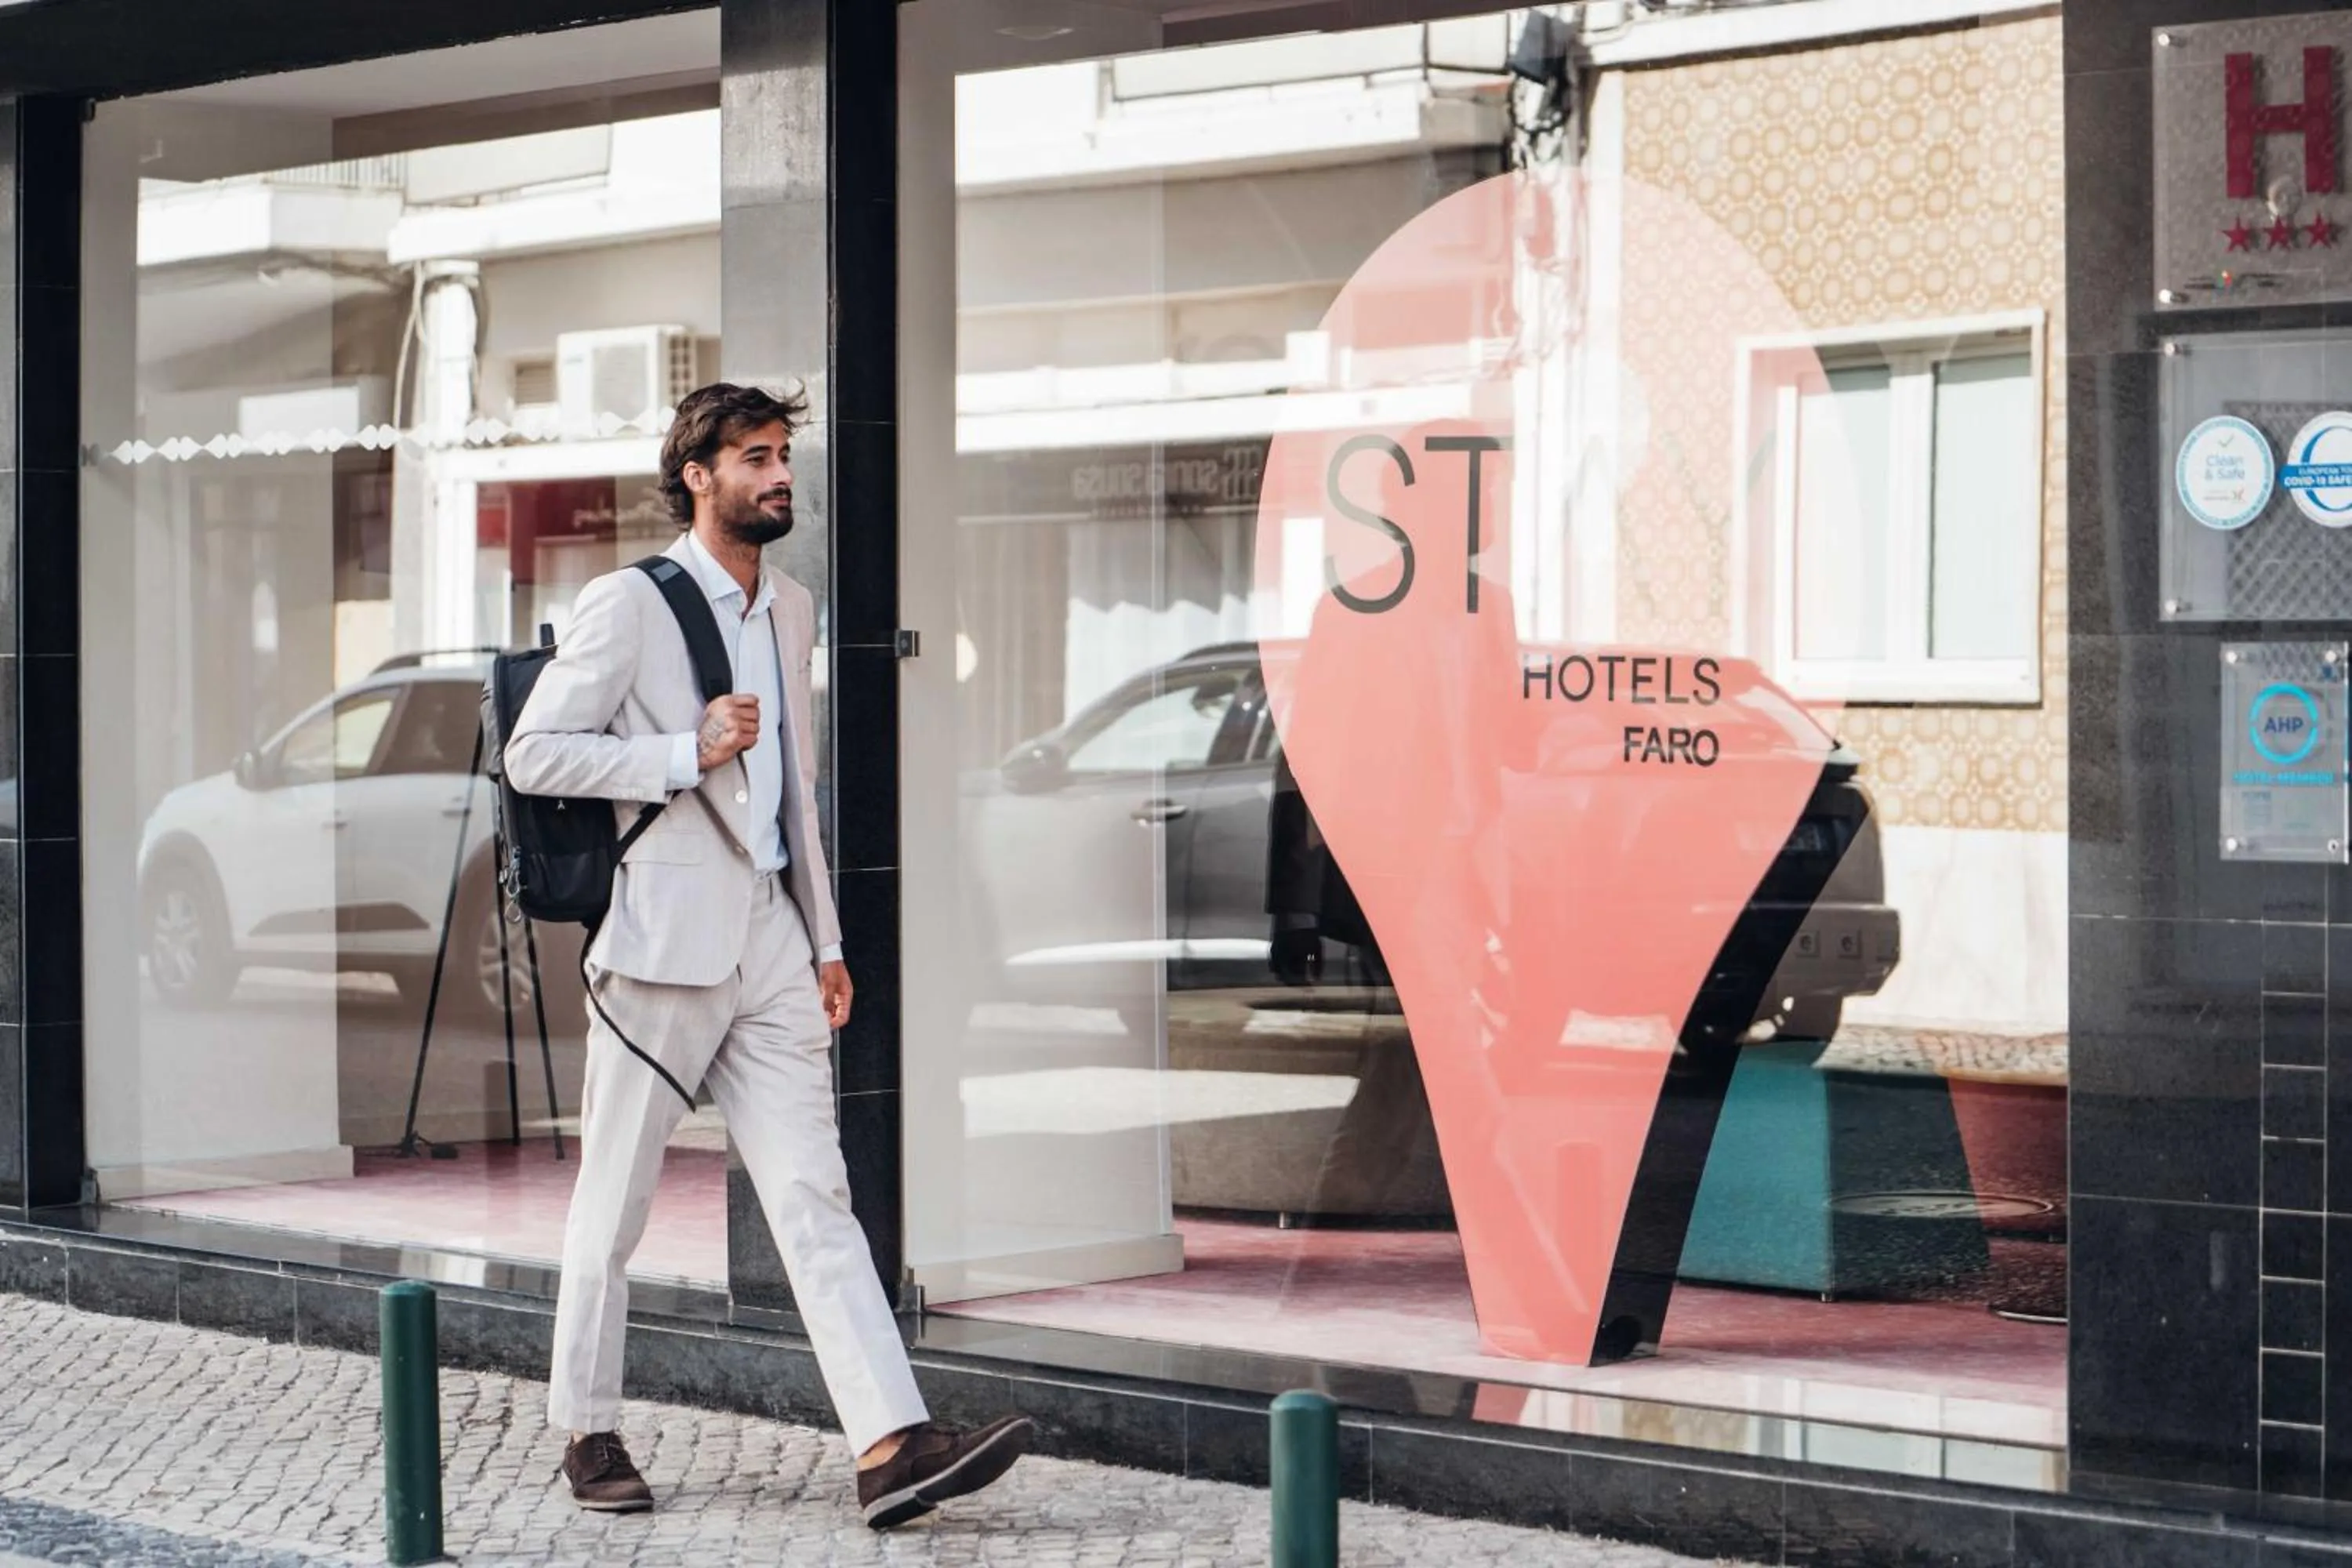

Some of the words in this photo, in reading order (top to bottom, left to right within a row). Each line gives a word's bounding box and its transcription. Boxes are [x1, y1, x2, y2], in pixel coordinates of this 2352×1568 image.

[2224, 45, 2335, 199] H
[1523, 654, 1721, 706] HOTELS
[1624, 726, 1720, 767] FARO
[2264, 717, 2303, 734] AHP
